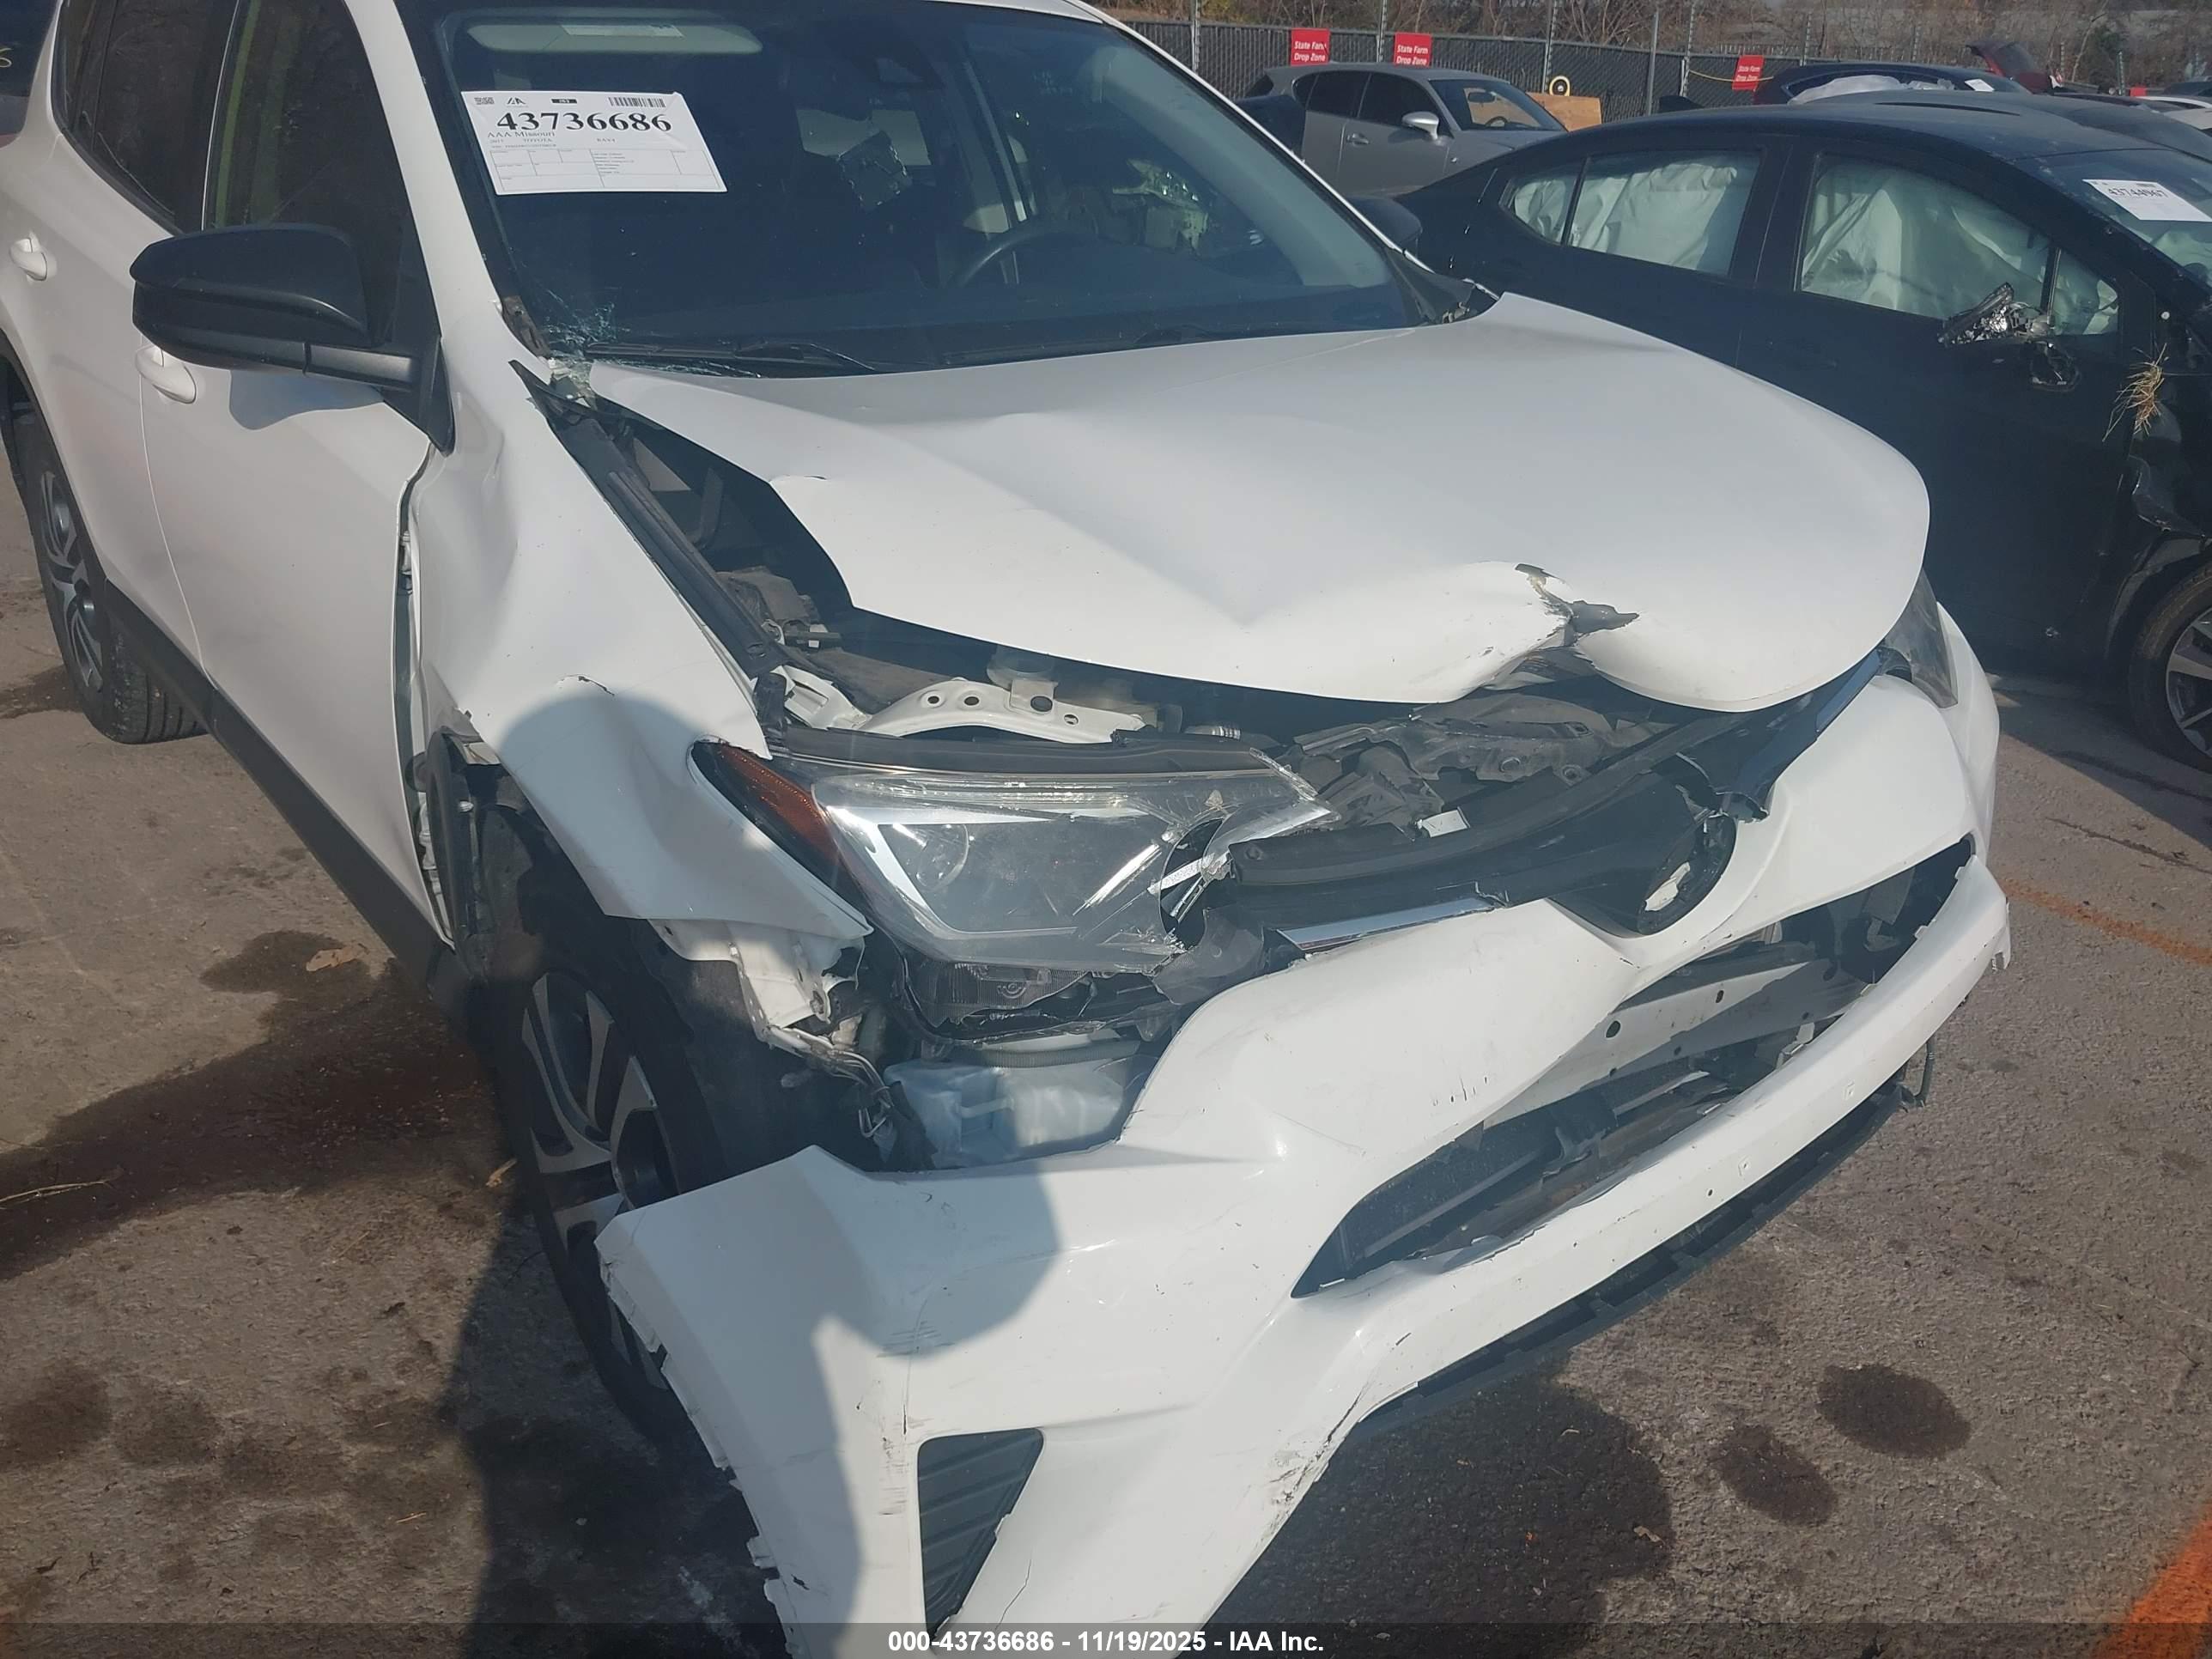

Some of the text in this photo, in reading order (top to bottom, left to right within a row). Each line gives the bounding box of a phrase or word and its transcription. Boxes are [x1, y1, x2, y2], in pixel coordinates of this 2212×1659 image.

[1294, 40, 1310, 50] State
[1397, 44, 1429, 54] State Farm
[1294, 52, 1326, 62] Drop Zone
[1396, 55, 1427, 65] Drop Zone
[496, 112, 672, 132] 43736686
